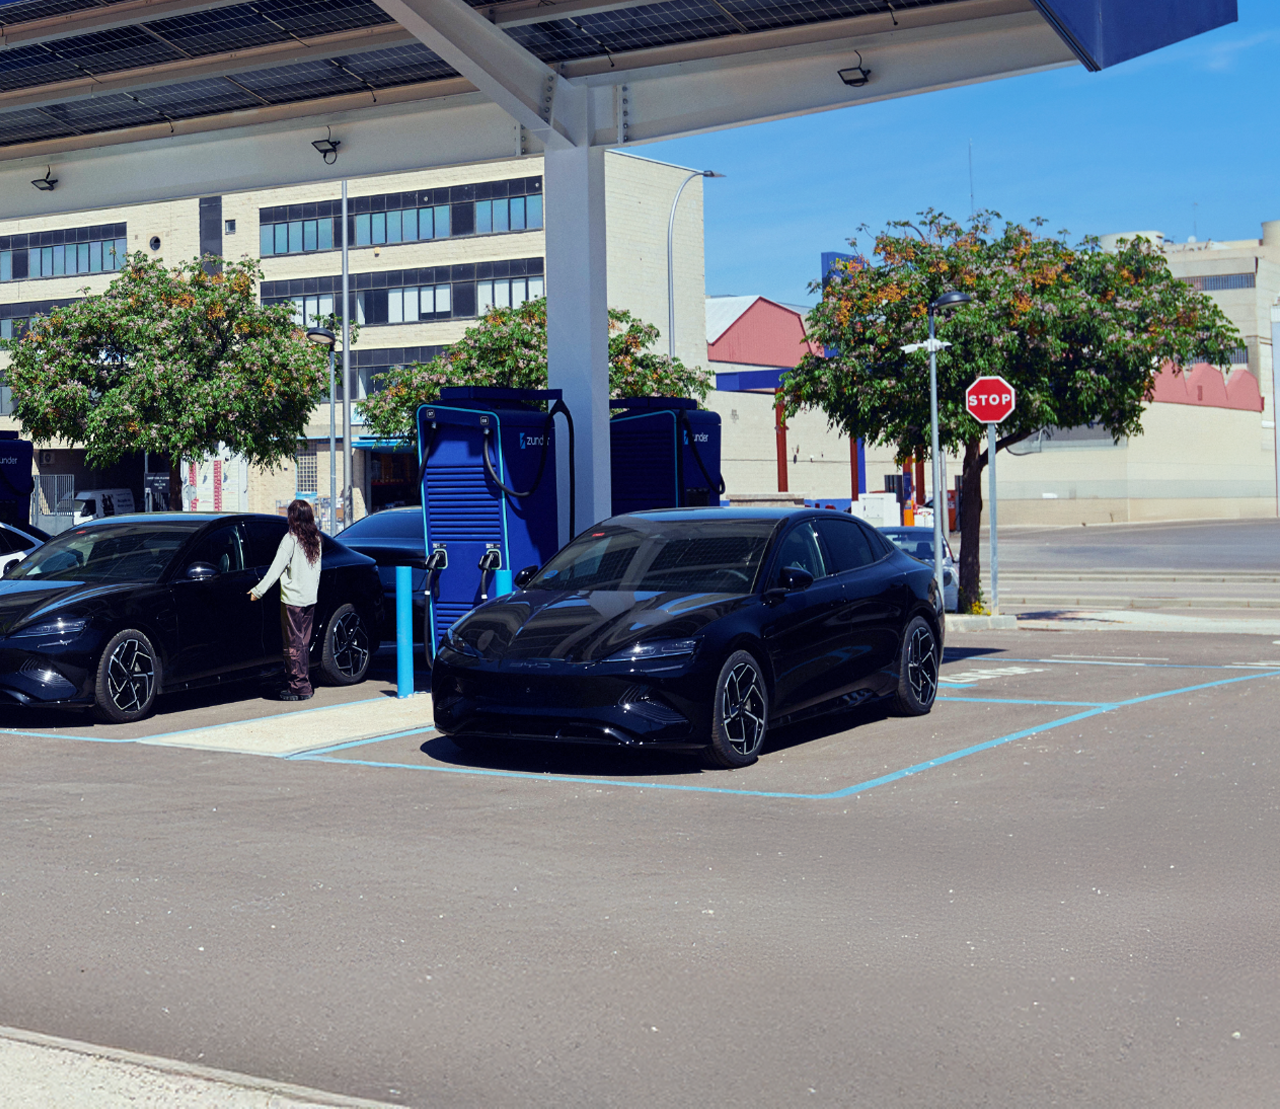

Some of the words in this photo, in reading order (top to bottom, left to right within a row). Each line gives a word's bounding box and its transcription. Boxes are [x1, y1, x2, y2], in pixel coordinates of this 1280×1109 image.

[968, 393, 1011, 406] STOP
[526, 434, 550, 446] zundr
[509, 661, 551, 669] BYD
